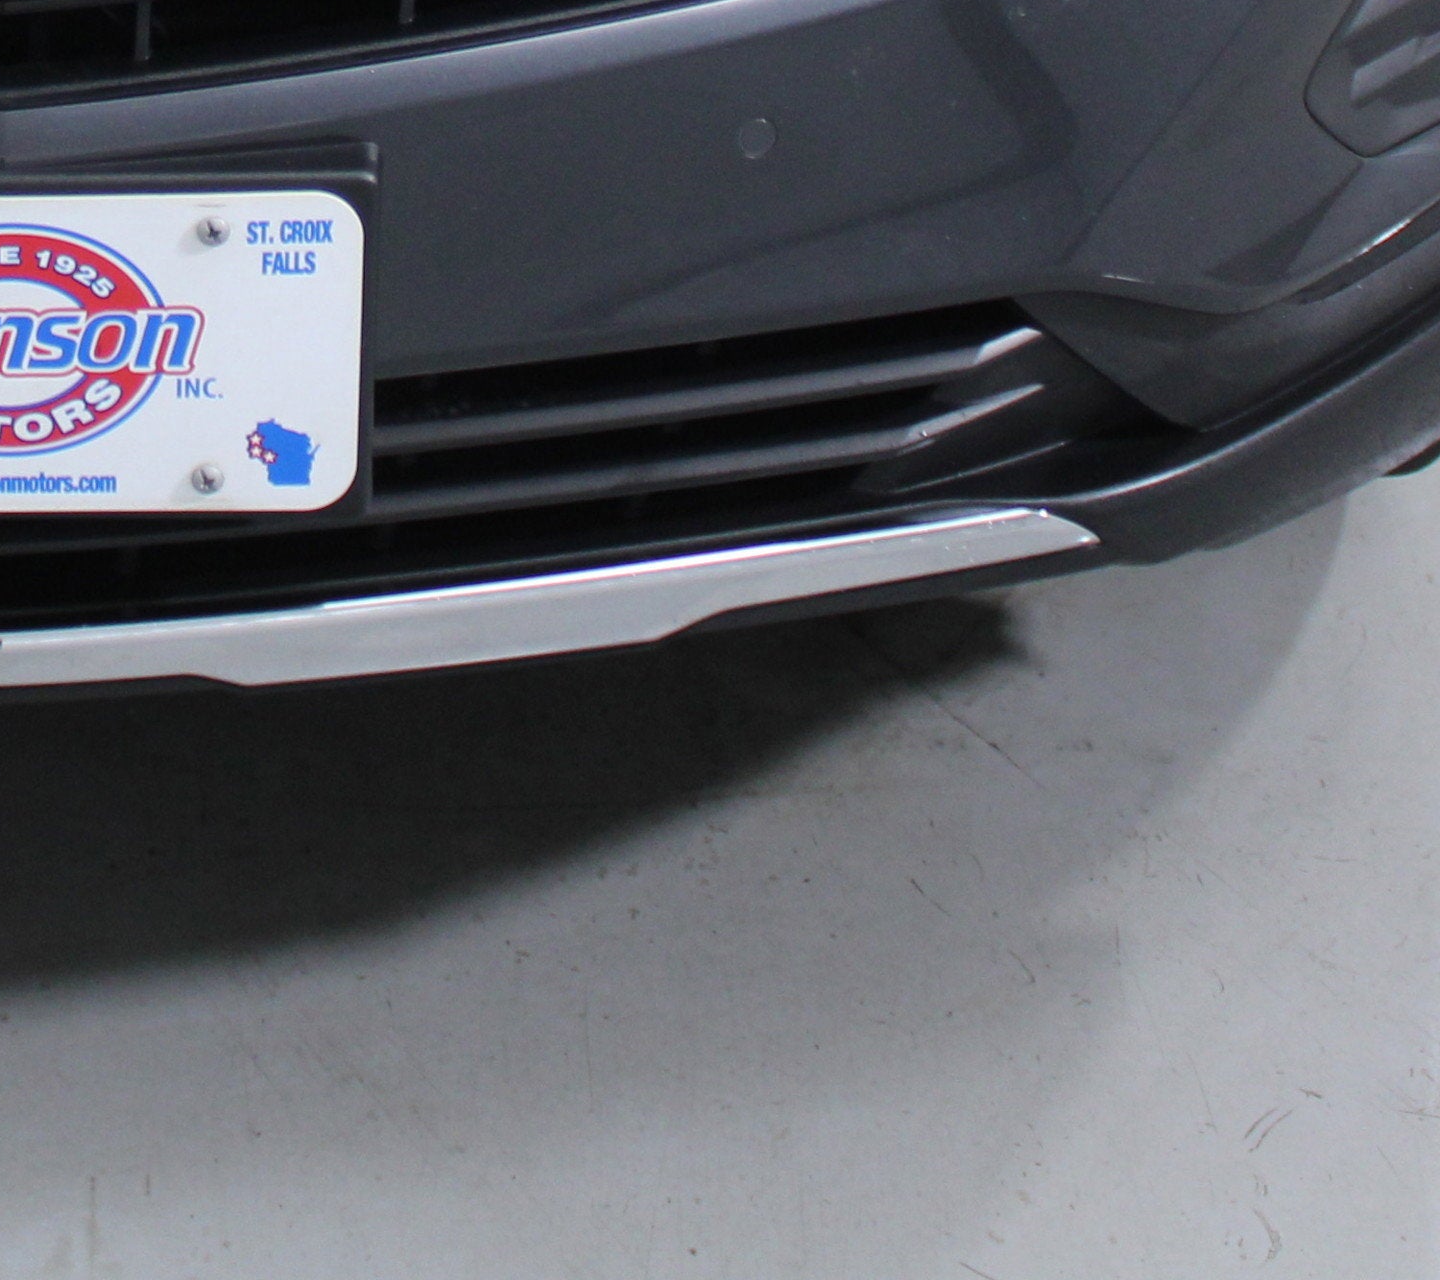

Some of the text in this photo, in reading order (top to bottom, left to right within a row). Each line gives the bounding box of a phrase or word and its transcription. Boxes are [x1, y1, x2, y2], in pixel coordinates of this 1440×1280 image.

[246, 220, 333, 245] ST. CROIX
[36, 250, 115, 298] 1925
[262, 251, 317, 276] FALLS
[176, 377, 224, 400] INC.
